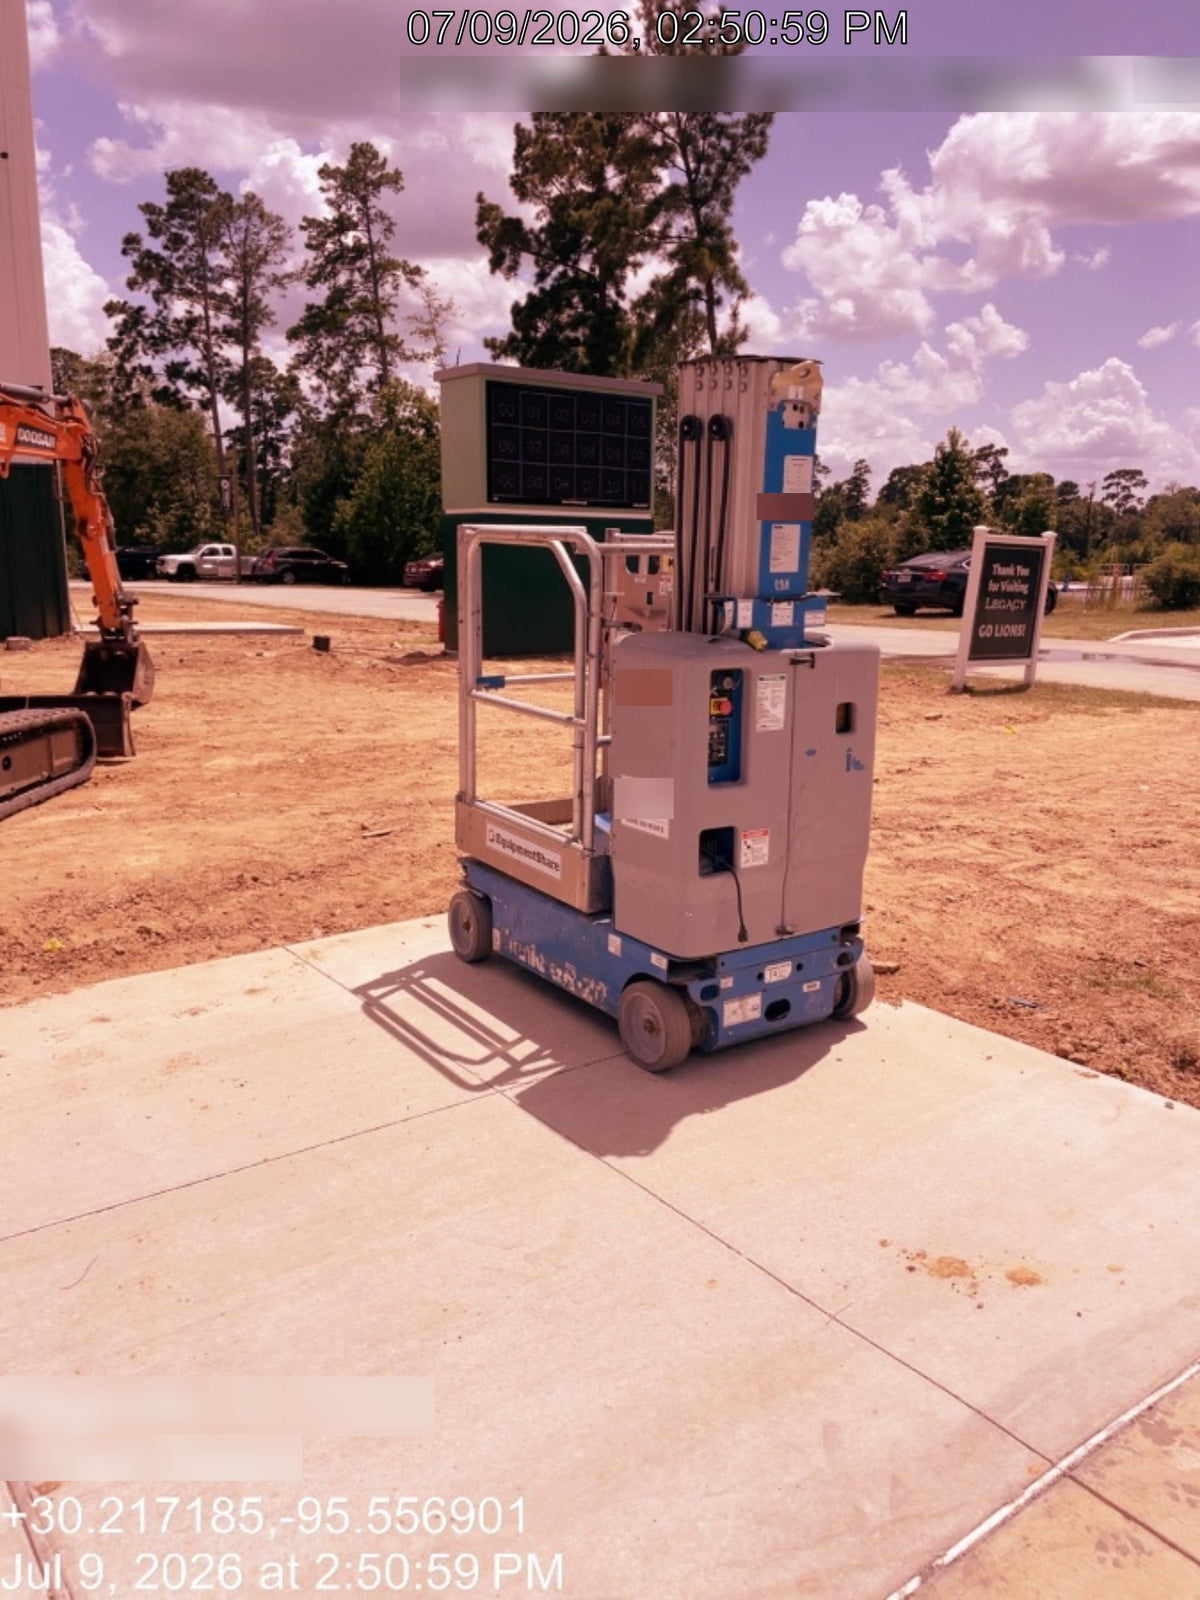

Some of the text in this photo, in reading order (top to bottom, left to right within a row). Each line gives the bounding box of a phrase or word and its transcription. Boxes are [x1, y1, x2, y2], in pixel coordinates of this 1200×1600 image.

[17, 428, 56, 449] DOOSAN
[992, 564, 1030, 577] Thank You
[988, 580, 1029, 595] for Visiting
[985, 598, 1026, 612] LEGACY
[979, 624, 1026, 638] GO LIONS!
[495, 833, 560, 872] EquipmentShare
